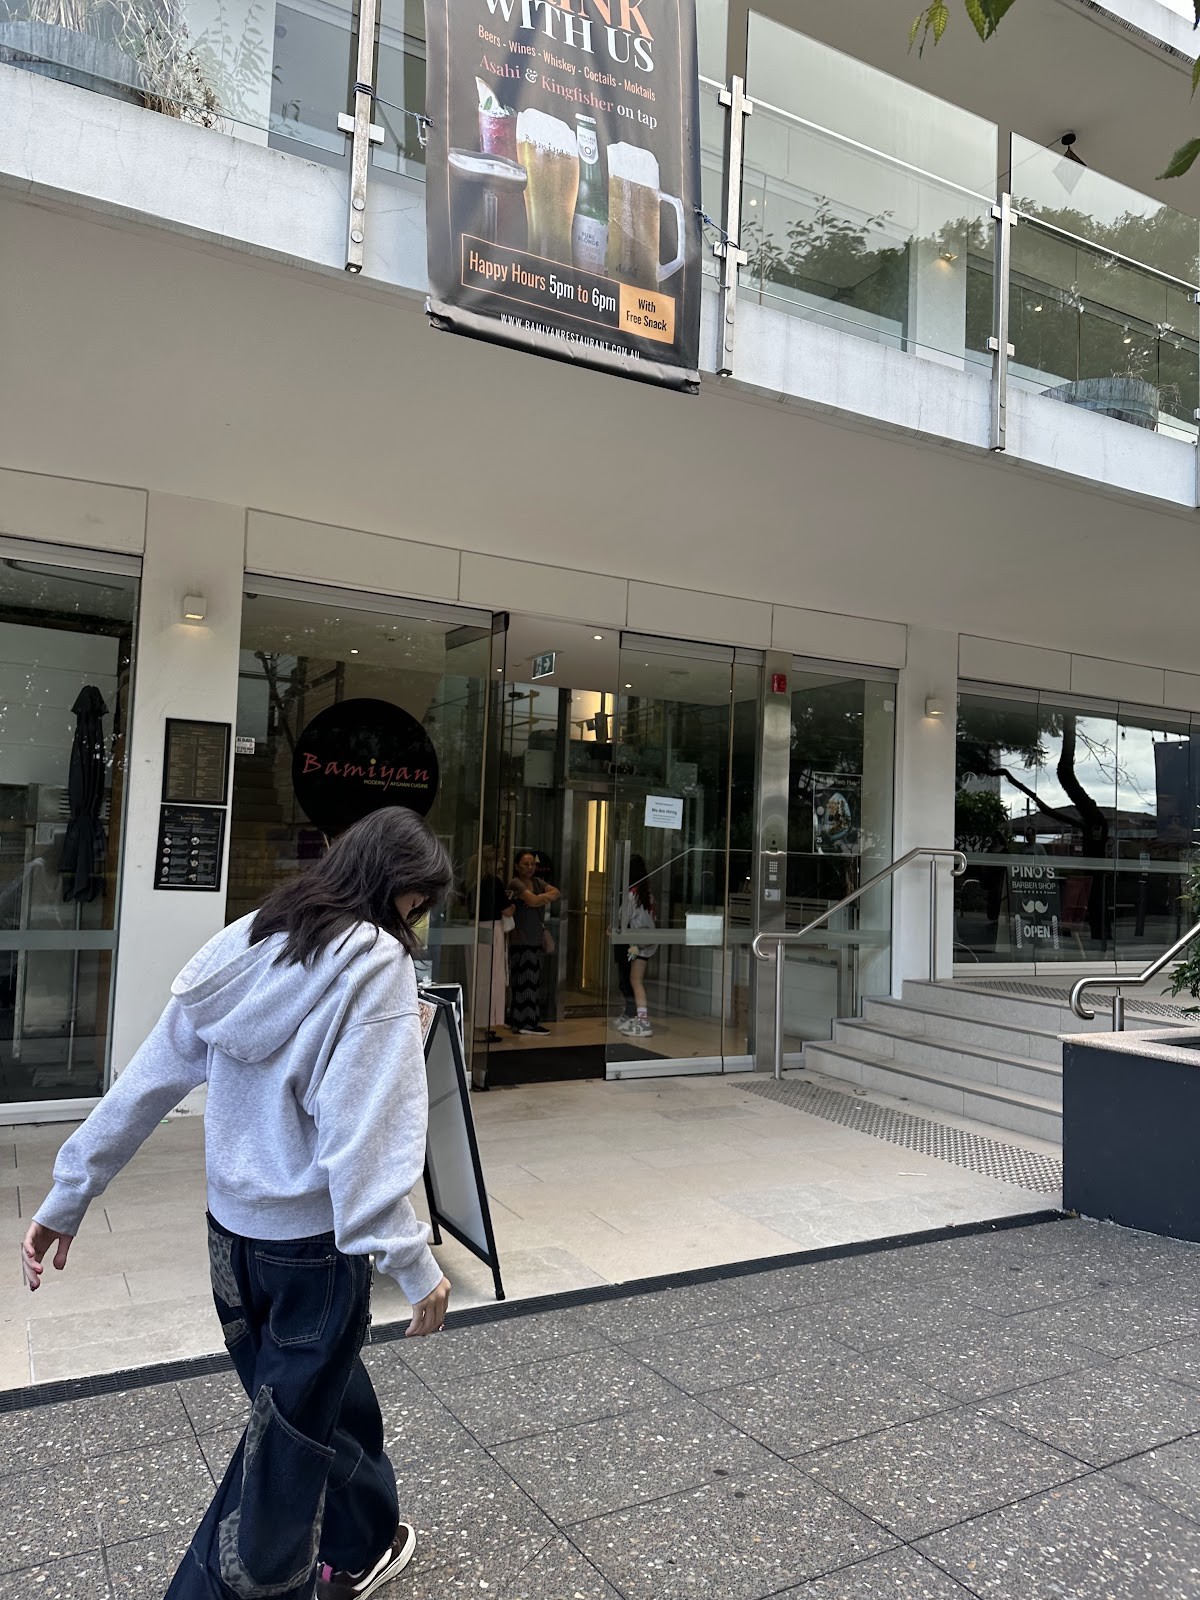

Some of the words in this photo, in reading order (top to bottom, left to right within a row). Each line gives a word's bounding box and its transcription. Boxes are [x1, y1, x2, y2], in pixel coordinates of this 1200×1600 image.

[486, 0, 594, 54] WITH
[604, 25, 654, 72] US
[478, 24, 501, 48] Beers
[508, 40, 536, 57] Wines
[543, 50, 576, 76] Whiskey
[584, 66, 616, 88] Coctails
[624, 80, 656, 101] Moktails
[479, 54, 521, 80] Asahi
[524, 68, 538, 83] &
[542, 76, 613, 112] Kingfisher
[617, 104, 634, 119] on
[637, 111, 658, 130] tap
[469, 251, 508, 282] Happy
[512, 262, 546, 290] Hours
[549, 274, 574, 300] 5pm
[577, 285, 588, 304] to
[592, 286, 616, 312] 6pm
[626, 311, 642, 326] Free
[644, 315, 667, 332] Snack
[638, 299, 656, 313] With
[500, 313, 640, 361] WWW.BAMIYANRESTAURANT.COM.AU
[303, 752, 430, 791] Bamiyan
[1011, 866, 1056, 879] PINO'S
[1012, 882, 1037, 890] BARBER
[1038, 882, 1056, 890] SHOP
[1024, 925, 1051, 938] OPEN
